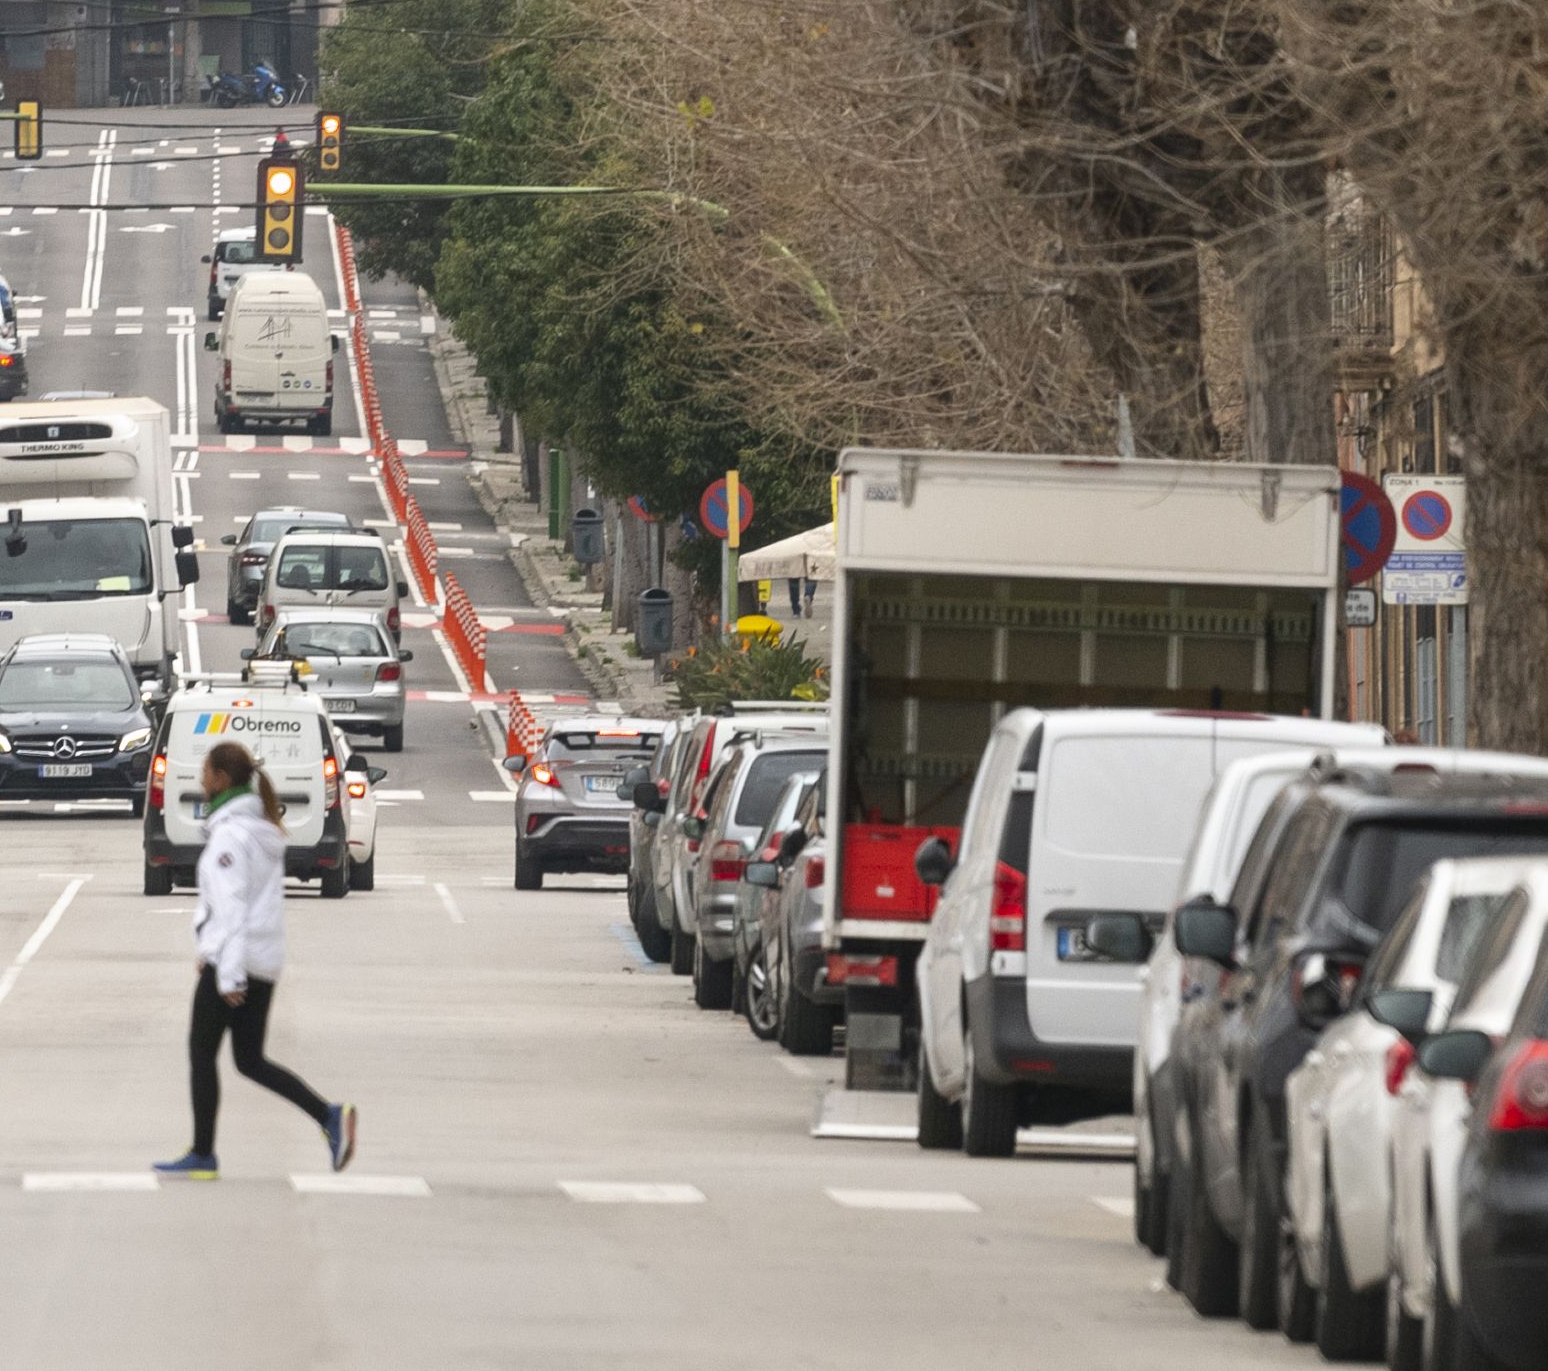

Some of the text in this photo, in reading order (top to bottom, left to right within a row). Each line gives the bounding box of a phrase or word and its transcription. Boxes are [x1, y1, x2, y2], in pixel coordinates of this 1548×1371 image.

[21, 442, 85, 453] THERMO KING
[231, 715, 301, 733] Obremo
